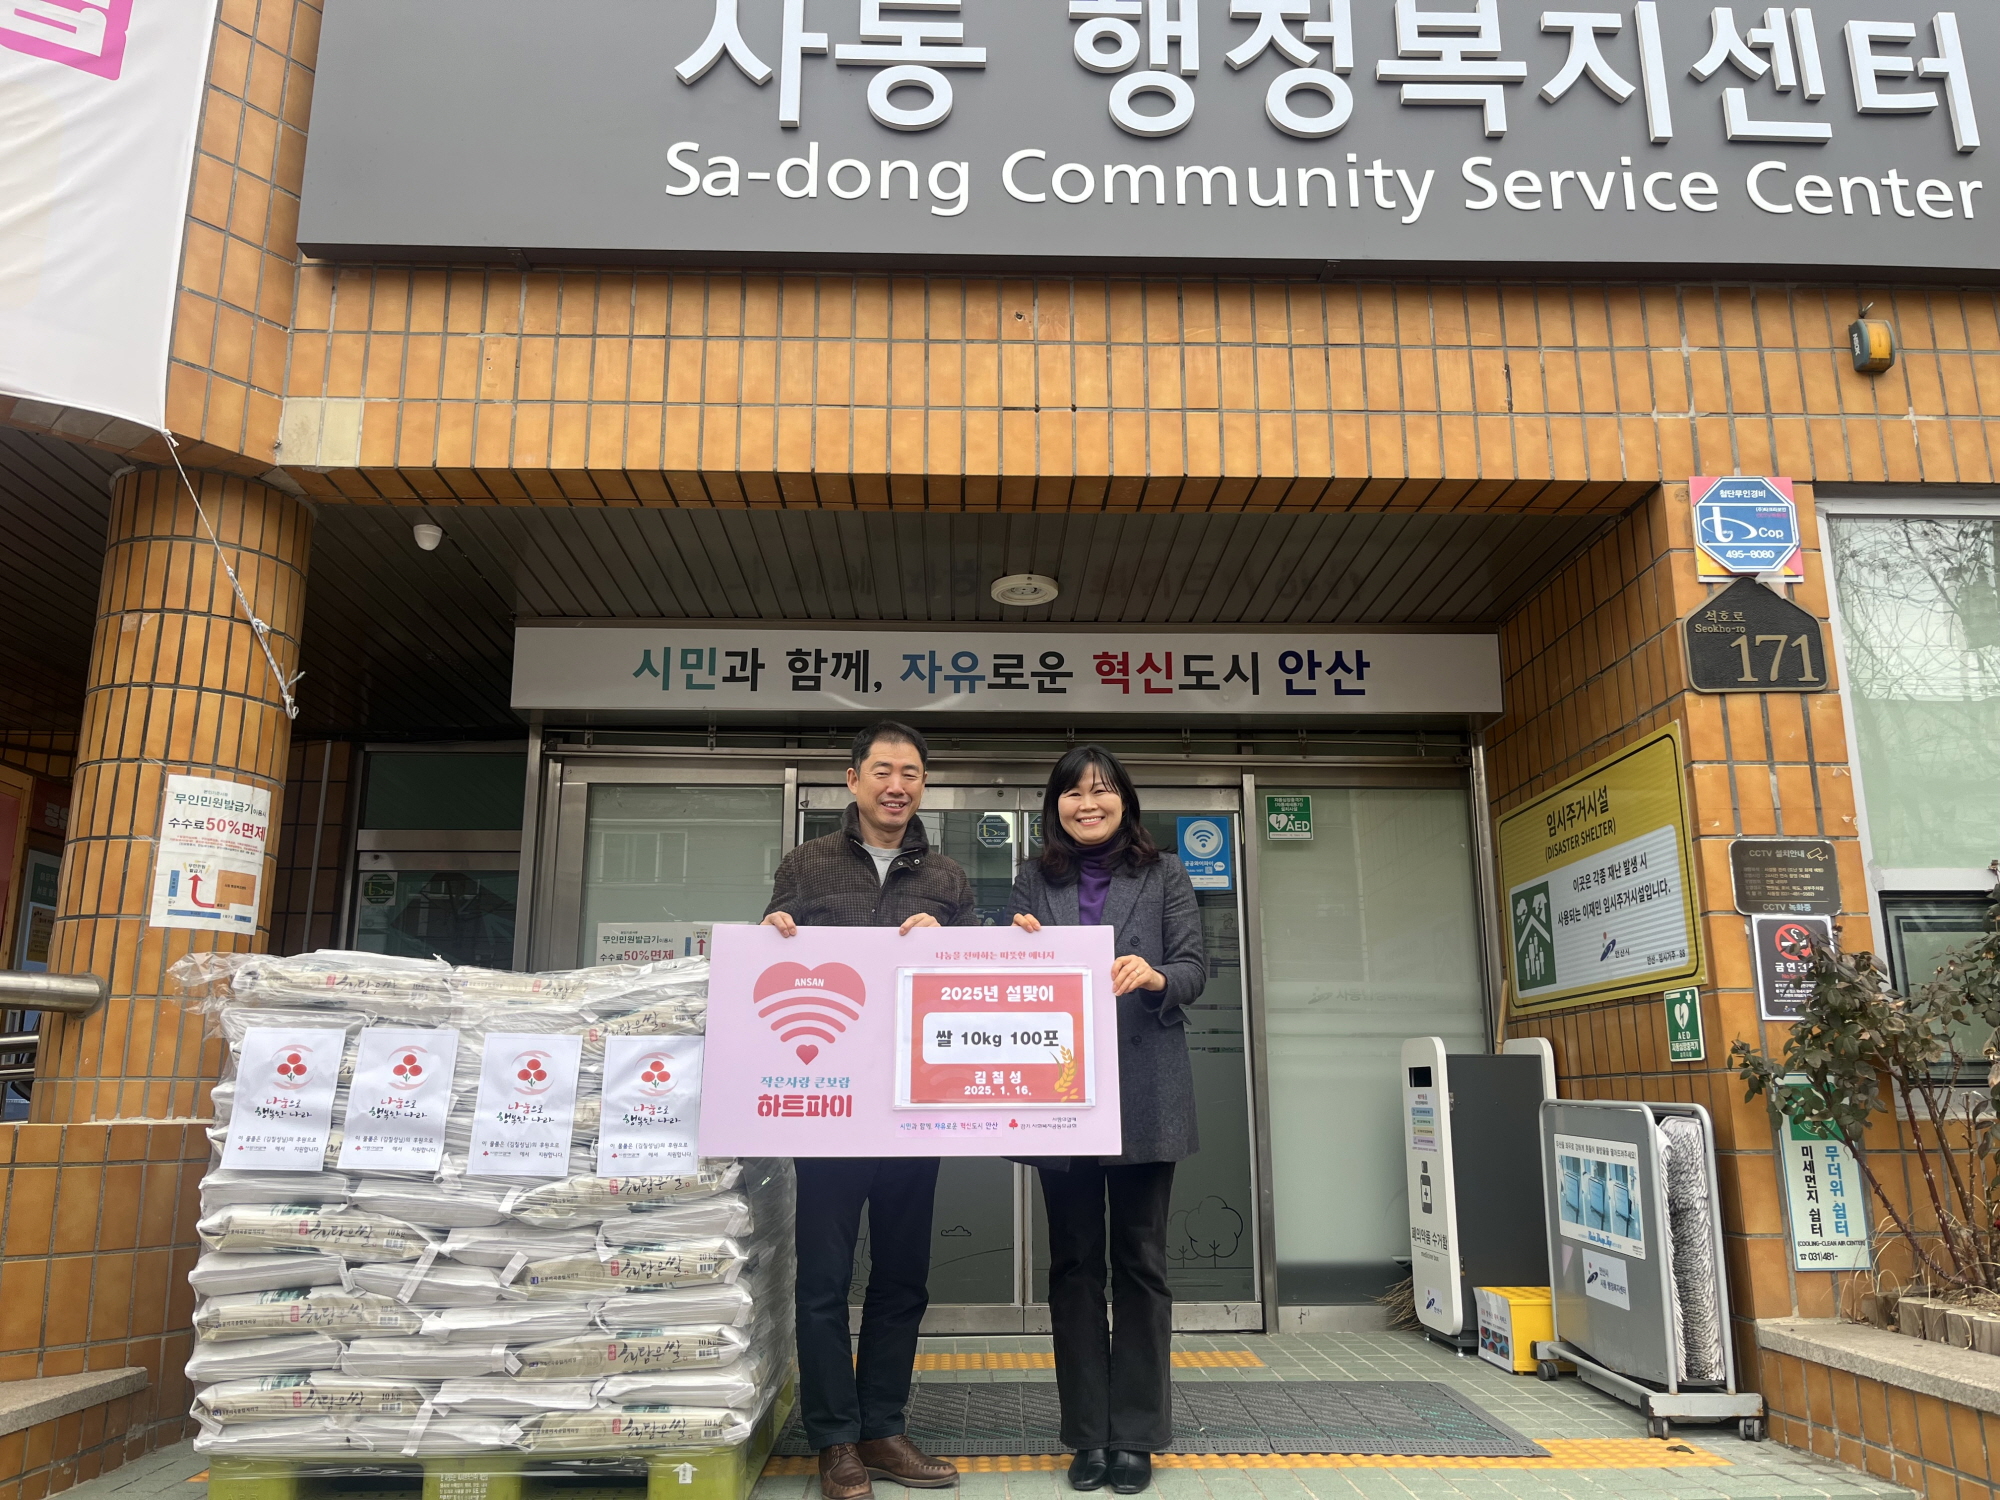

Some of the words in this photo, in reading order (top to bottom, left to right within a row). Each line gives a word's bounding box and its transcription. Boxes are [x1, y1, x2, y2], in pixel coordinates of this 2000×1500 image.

[675, 0, 988, 131] 사동
[1073, 0, 1981, 154] 행정복지센터
[663, 140, 972, 217] Sa-dong
[1001, 148, 1436, 225] Community
[1466, 156, 1719, 213] Service
[1746, 160, 1984, 219] Center
[1852, 333, 1861, 356] NSOK
[1758, 526, 1784, 539] Cop
[1726, 549, 1775, 559] 495-8080
[1704, 610, 1746, 622] 석호로
[1695, 624, 1746, 634] Seokho-ro
[1730, 634, 1819, 682] 171
[631, 647, 765, 694] 시민과
[785, 646, 884, 695] 함께,
[899, 649, 1074, 695] 자유로운
[1092, 649, 1262, 697] 혁신도시
[1277, 649, 1370, 697] 안산
[1546, 785, 1609, 838] 임시주거시설
[1286, 820, 1310, 831] AED
[1545, 834, 1580, 863] (DISASTER
[1581, 817, 1616, 846] SHELTER)
[1775, 850, 1805, 858] 설치안내
[1573, 874, 1592, 893] 이곳은
[1592, 868, 1606, 886] 각종
[1607, 861, 1621, 881] 재난
[1623, 855, 1638, 876] 발생
[1639, 852, 1648, 870] 시
[1557, 907, 1581, 927] 사용되는
[1582, 899, 1602, 919] 이재민
[1603, 878, 1671, 914] 임시주거시설입니다.
[1789, 903, 1811, 911] 녹화중
[935, 951, 960, 960] 나눔을
[1000, 951, 1026, 960] 따뜻한
[1028, 951, 1055, 960] 에너지
[1615, 948, 1630, 958] 안산시
[794, 977, 825, 987] ANSAN
[941, 985, 998, 1002] 2025년
[1006, 985, 1054, 1002] 설맞이
[936, 1030, 953, 1047] 쌀
[961, 1031, 1002, 1047] 10kg
[1010, 1030, 1059, 1047] 100포
[1678, 1031, 1691, 1040] AED
[760, 1076, 810, 1088] 작은사랑
[814, 1076, 850, 1088] 큰보람
[964, 1086, 995, 1096] 2025.
[1000, 1086, 1010, 1096] 1.
[1015, 1086, 1032, 1096] 16.
[266, 1097, 301, 1108] 나눔으로
[381, 1097, 416, 1108] 나눔으로
[508, 1102, 543, 1114] 나눔으로
[634, 1104, 669, 1115] 나눔으로
[757, 1094, 852, 1118] 하트파이
[254, 1106, 286, 1120] 행복한
[369, 1106, 401, 1120] 행복한
[496, 1111, 528, 1125] 행복한
[623, 1114, 655, 1127] 행복한
[900, 1122, 917, 1130] 시민과
[934, 1122, 957, 1130] 자유로운
[960, 1122, 983, 1130] 혁신도시
[985, 1122, 998, 1130] 안산
[1801, 1146, 1819, 1204] 미세먼지
[1825, 1146, 1844, 1197] 무더위
[1809, 1208, 1823, 1237] 쉼터
[1832, 1203, 1849, 1237] 쉼터
[1412, 1226, 1431, 1245] 폐의약품
[1432, 1232, 1448, 1250] 수거함
